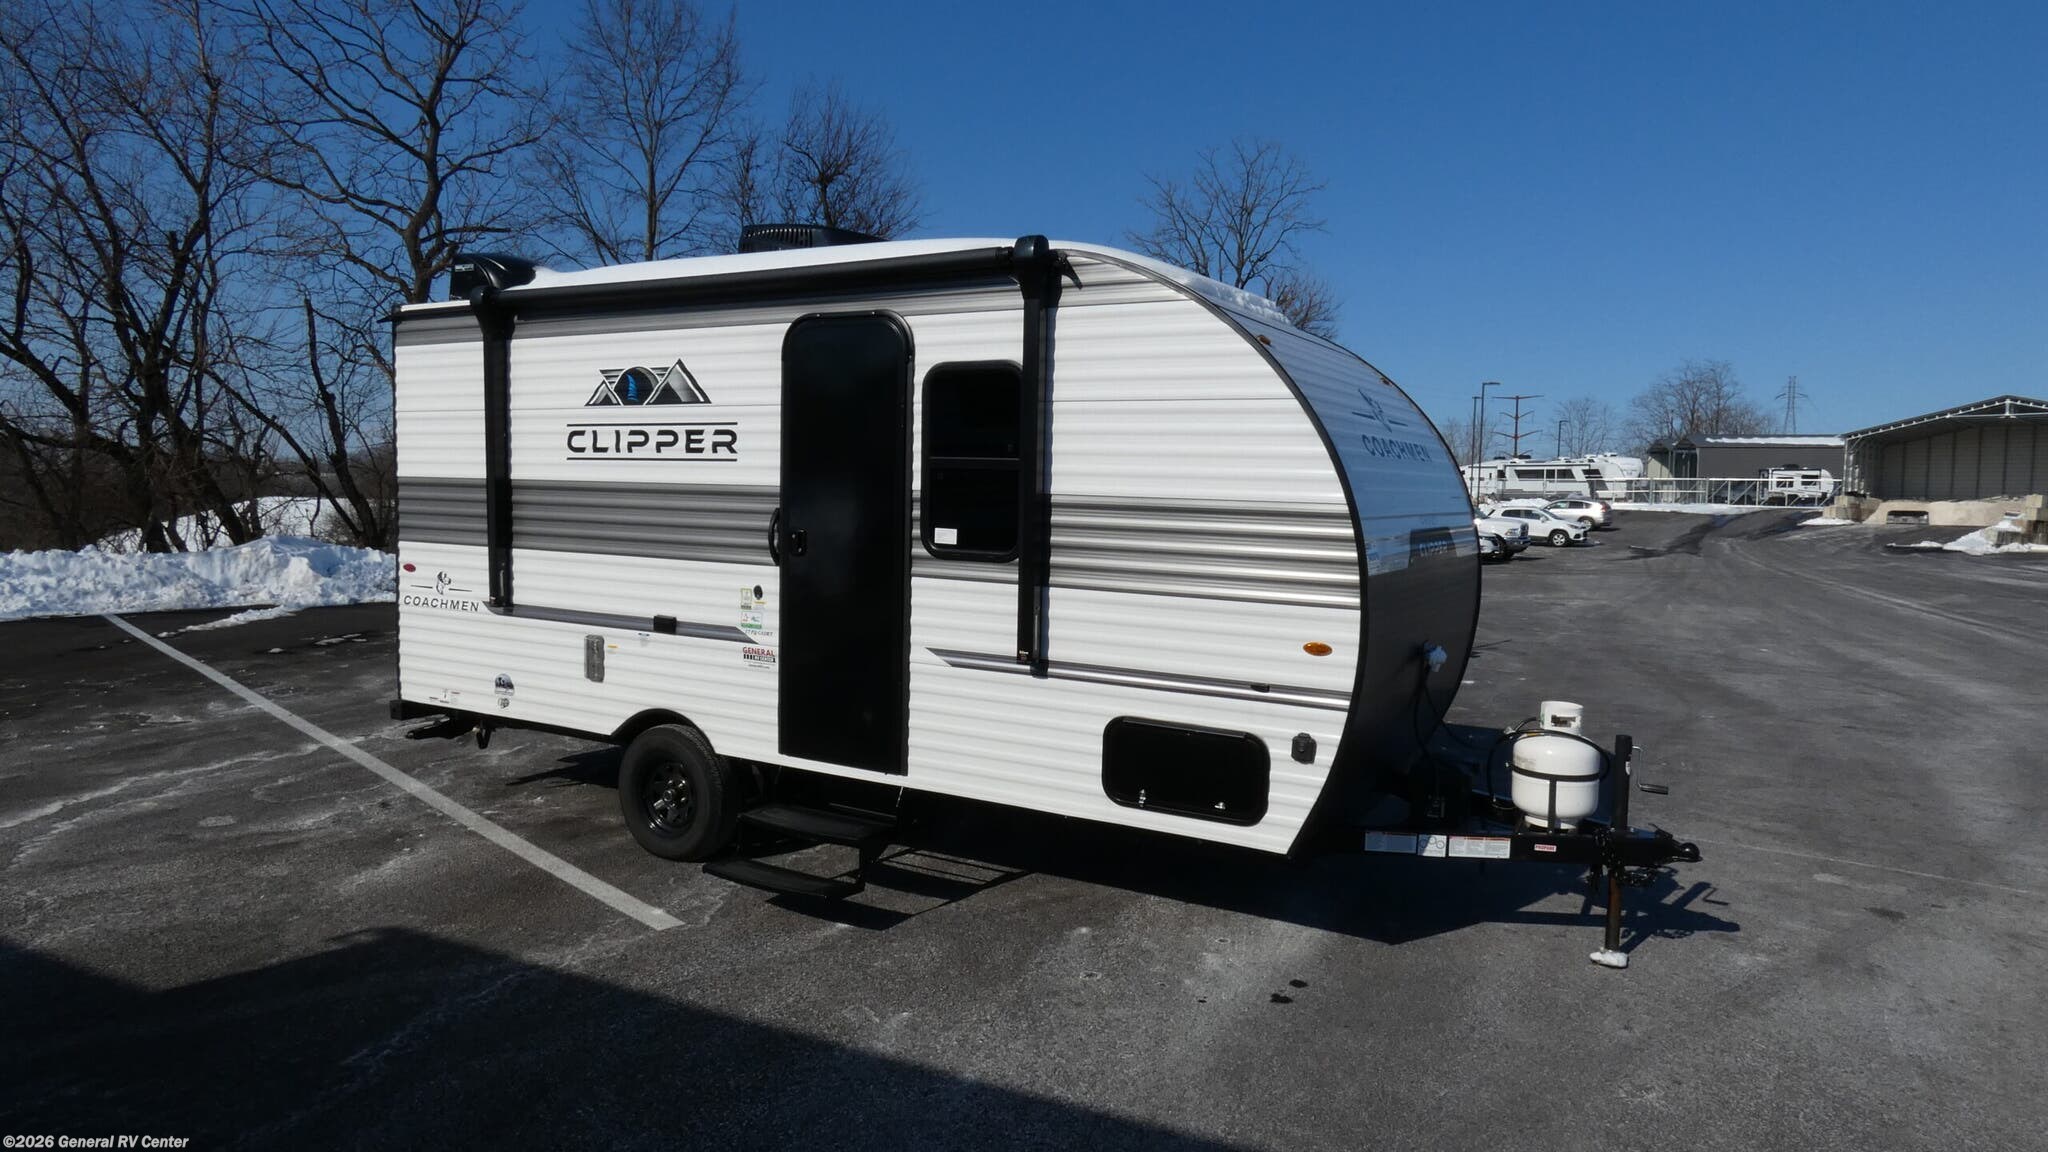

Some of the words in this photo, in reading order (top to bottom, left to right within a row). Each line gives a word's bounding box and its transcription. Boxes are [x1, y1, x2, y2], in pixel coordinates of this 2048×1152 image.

[566, 429, 738, 454] CLIPPER
[1362, 434, 1432, 462] COACHMEN
[403, 594, 480, 612] COACHMEN
[743, 647, 775, 656] GENERAL
